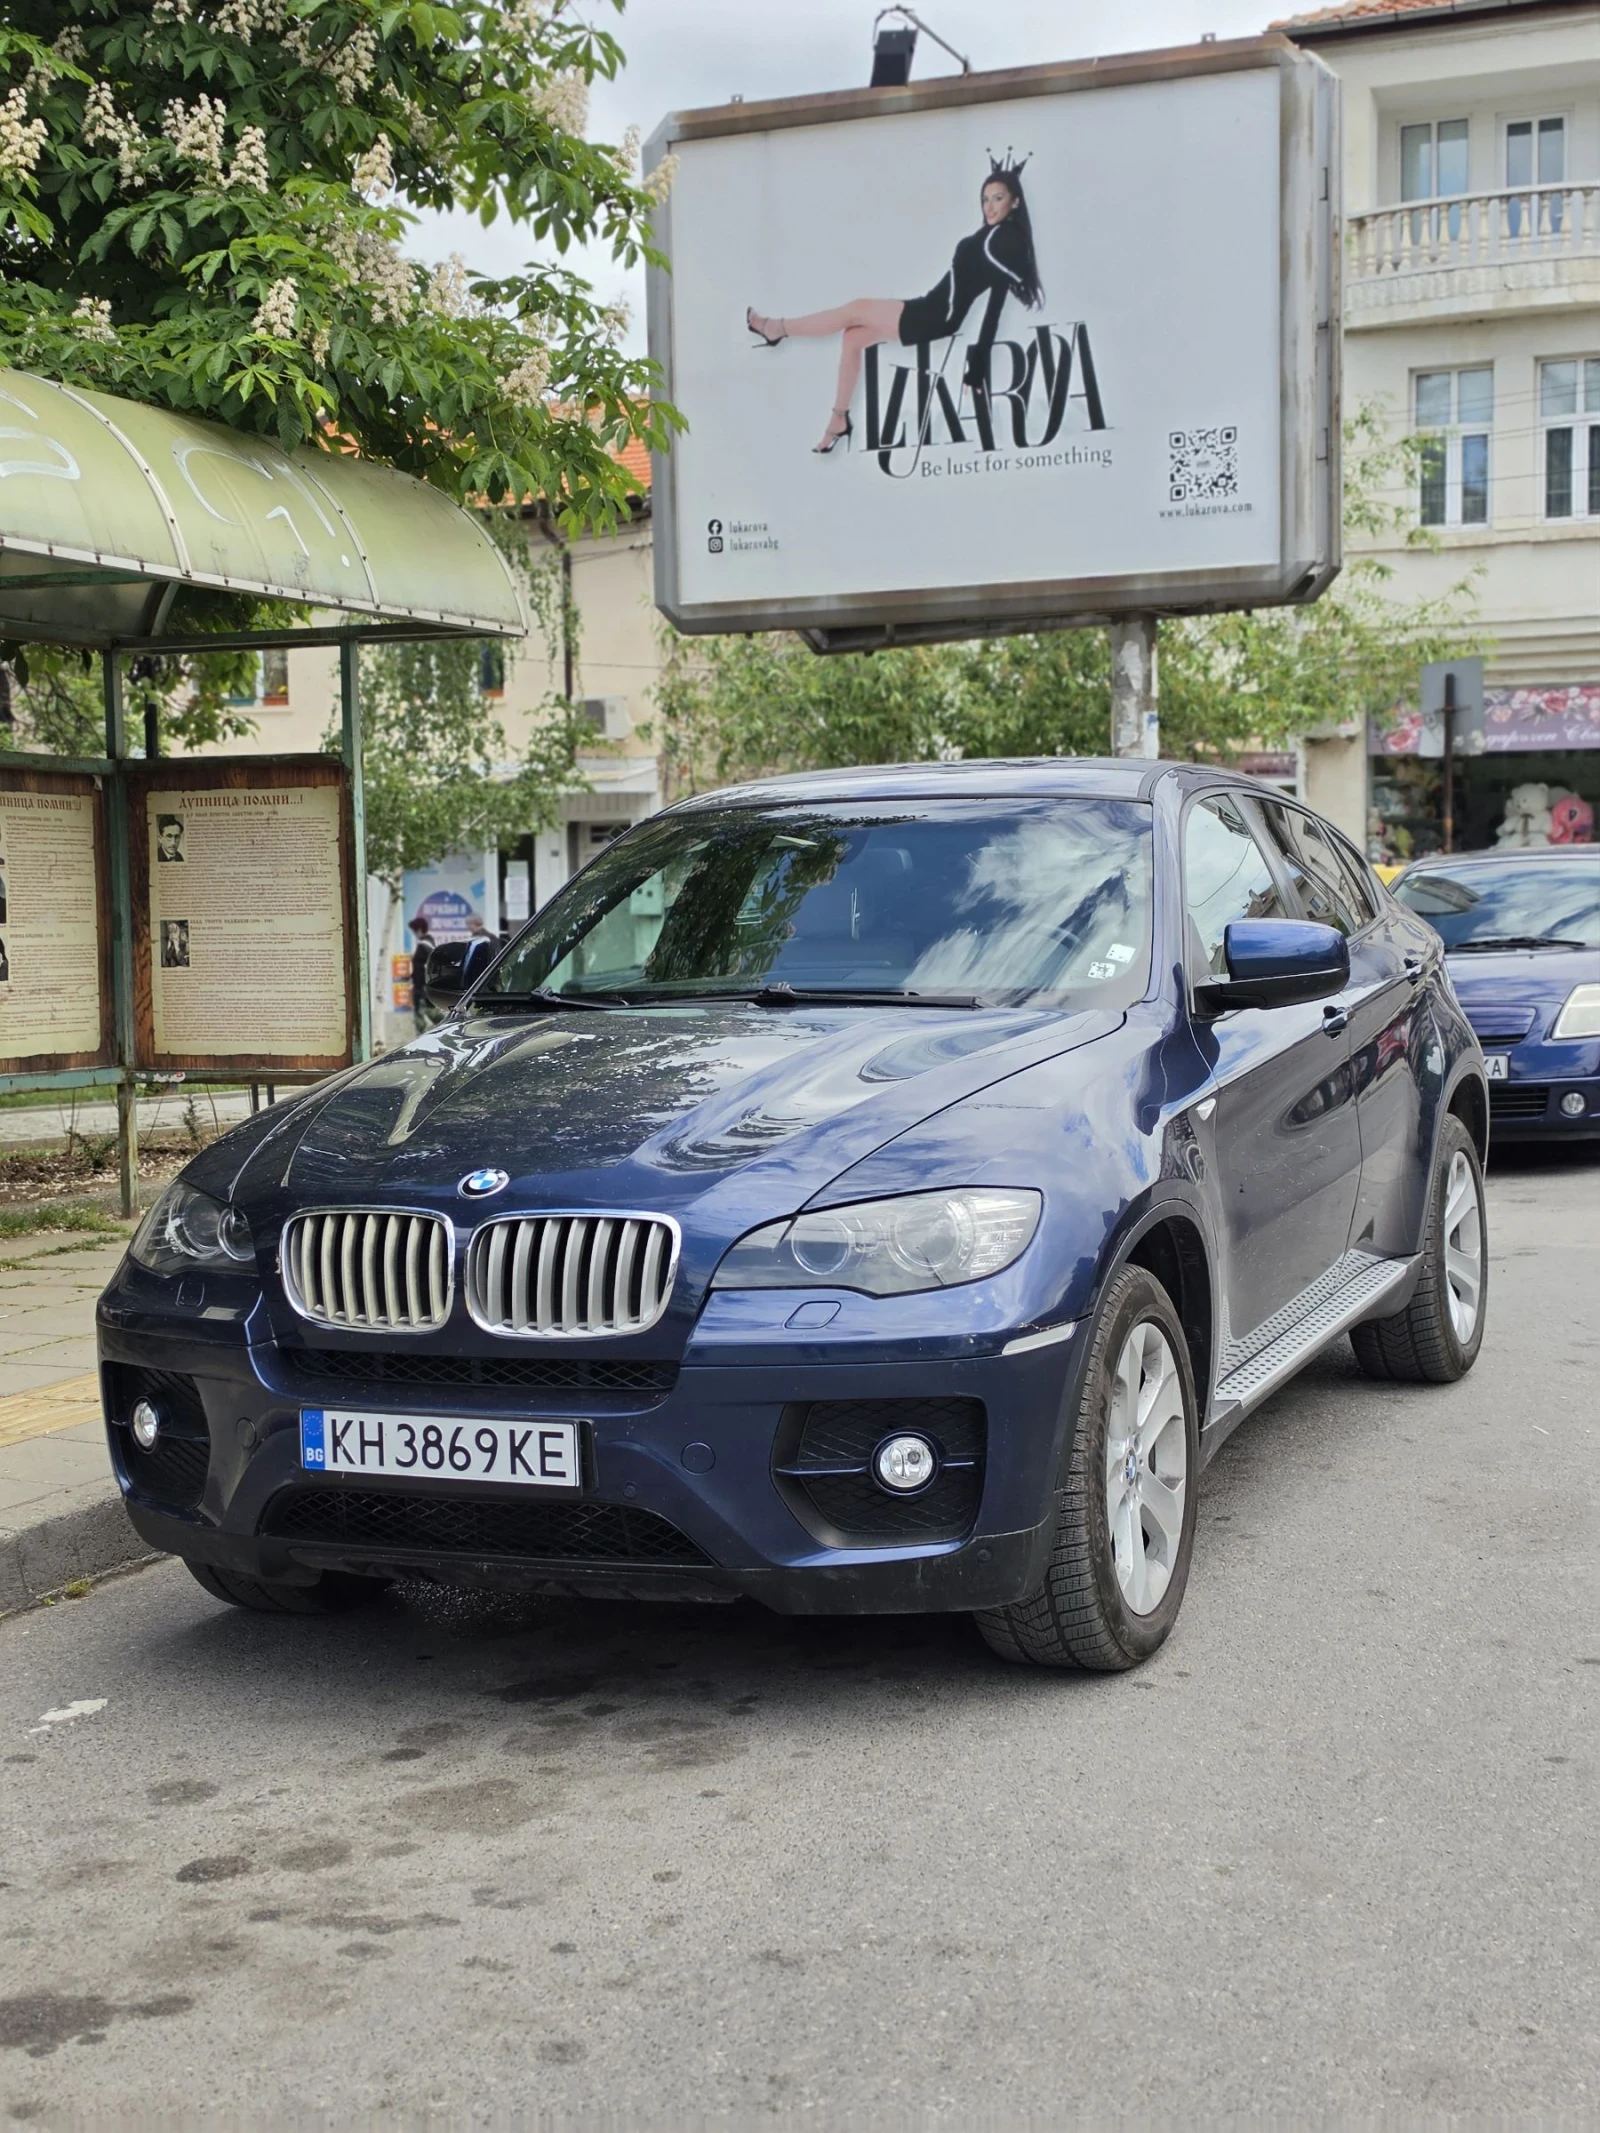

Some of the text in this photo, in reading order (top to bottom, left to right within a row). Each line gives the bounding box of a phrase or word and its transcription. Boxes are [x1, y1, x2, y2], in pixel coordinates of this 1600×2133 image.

[921, 446, 1113, 478] Be lust for something
[1159, 503, 1252, 518] www.lukarova.com
[728, 521, 768, 534] lukarova
[729, 536, 779, 551] lukarovabg
[178, 797, 239, 809] ДУПНИЦА
[306, 1447, 324, 1462] BG
